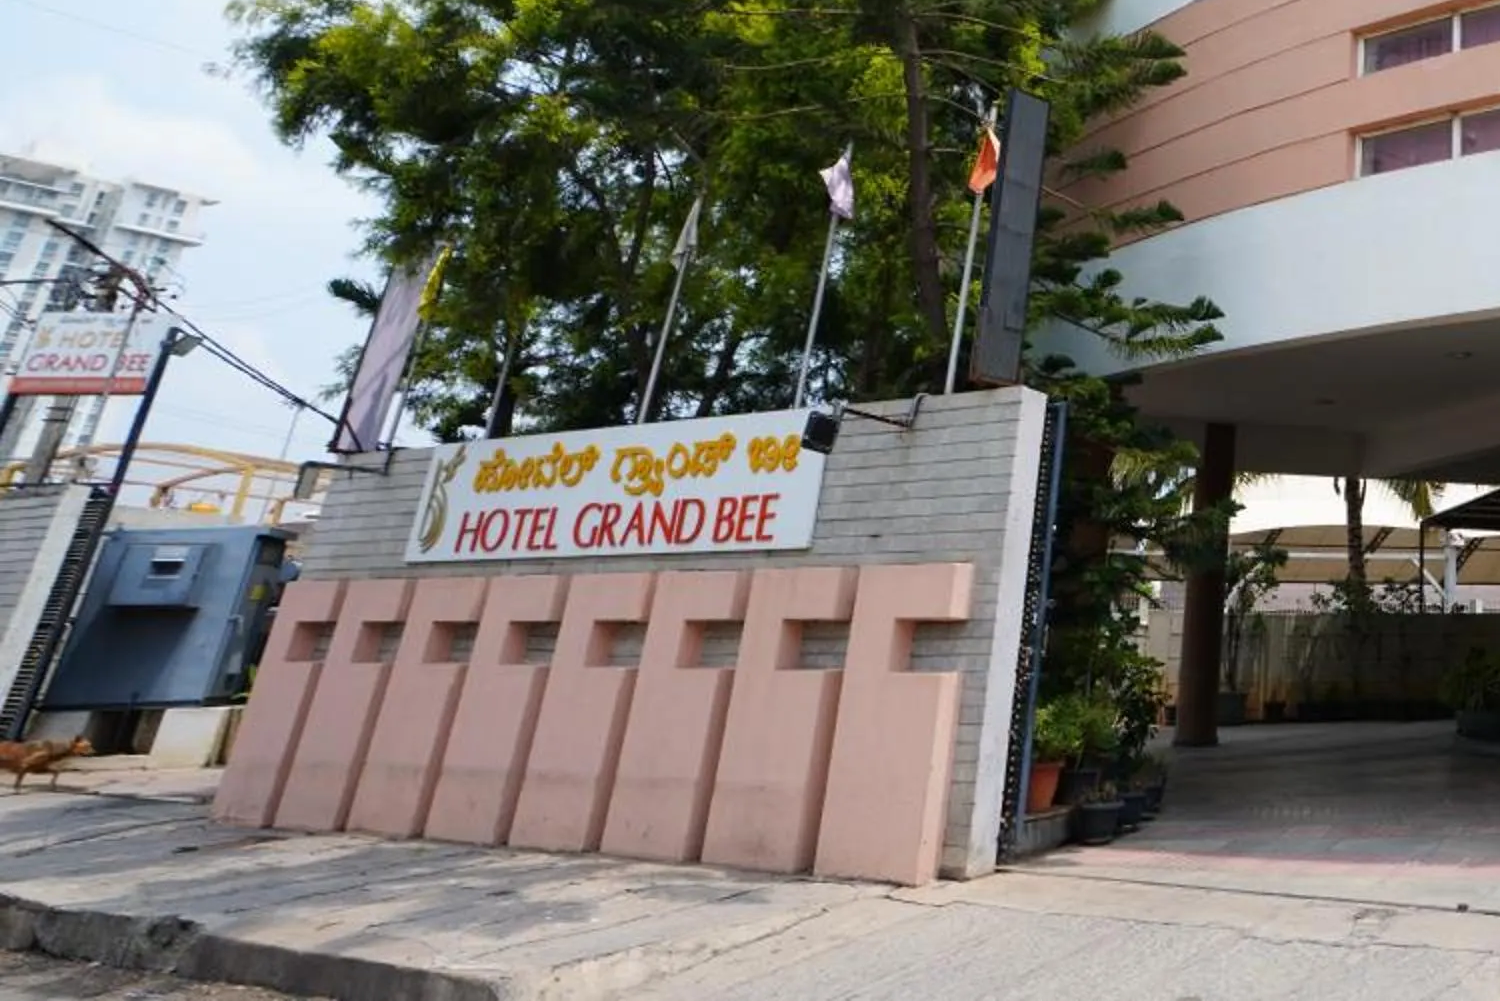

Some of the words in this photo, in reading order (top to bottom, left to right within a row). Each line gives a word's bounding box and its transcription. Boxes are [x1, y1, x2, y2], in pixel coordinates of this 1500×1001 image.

[26, 353, 109, 372] GRAND
[455, 506, 557, 553] HOTEL
[572, 498, 705, 547] GRAND
[713, 493, 781, 543] BEE
